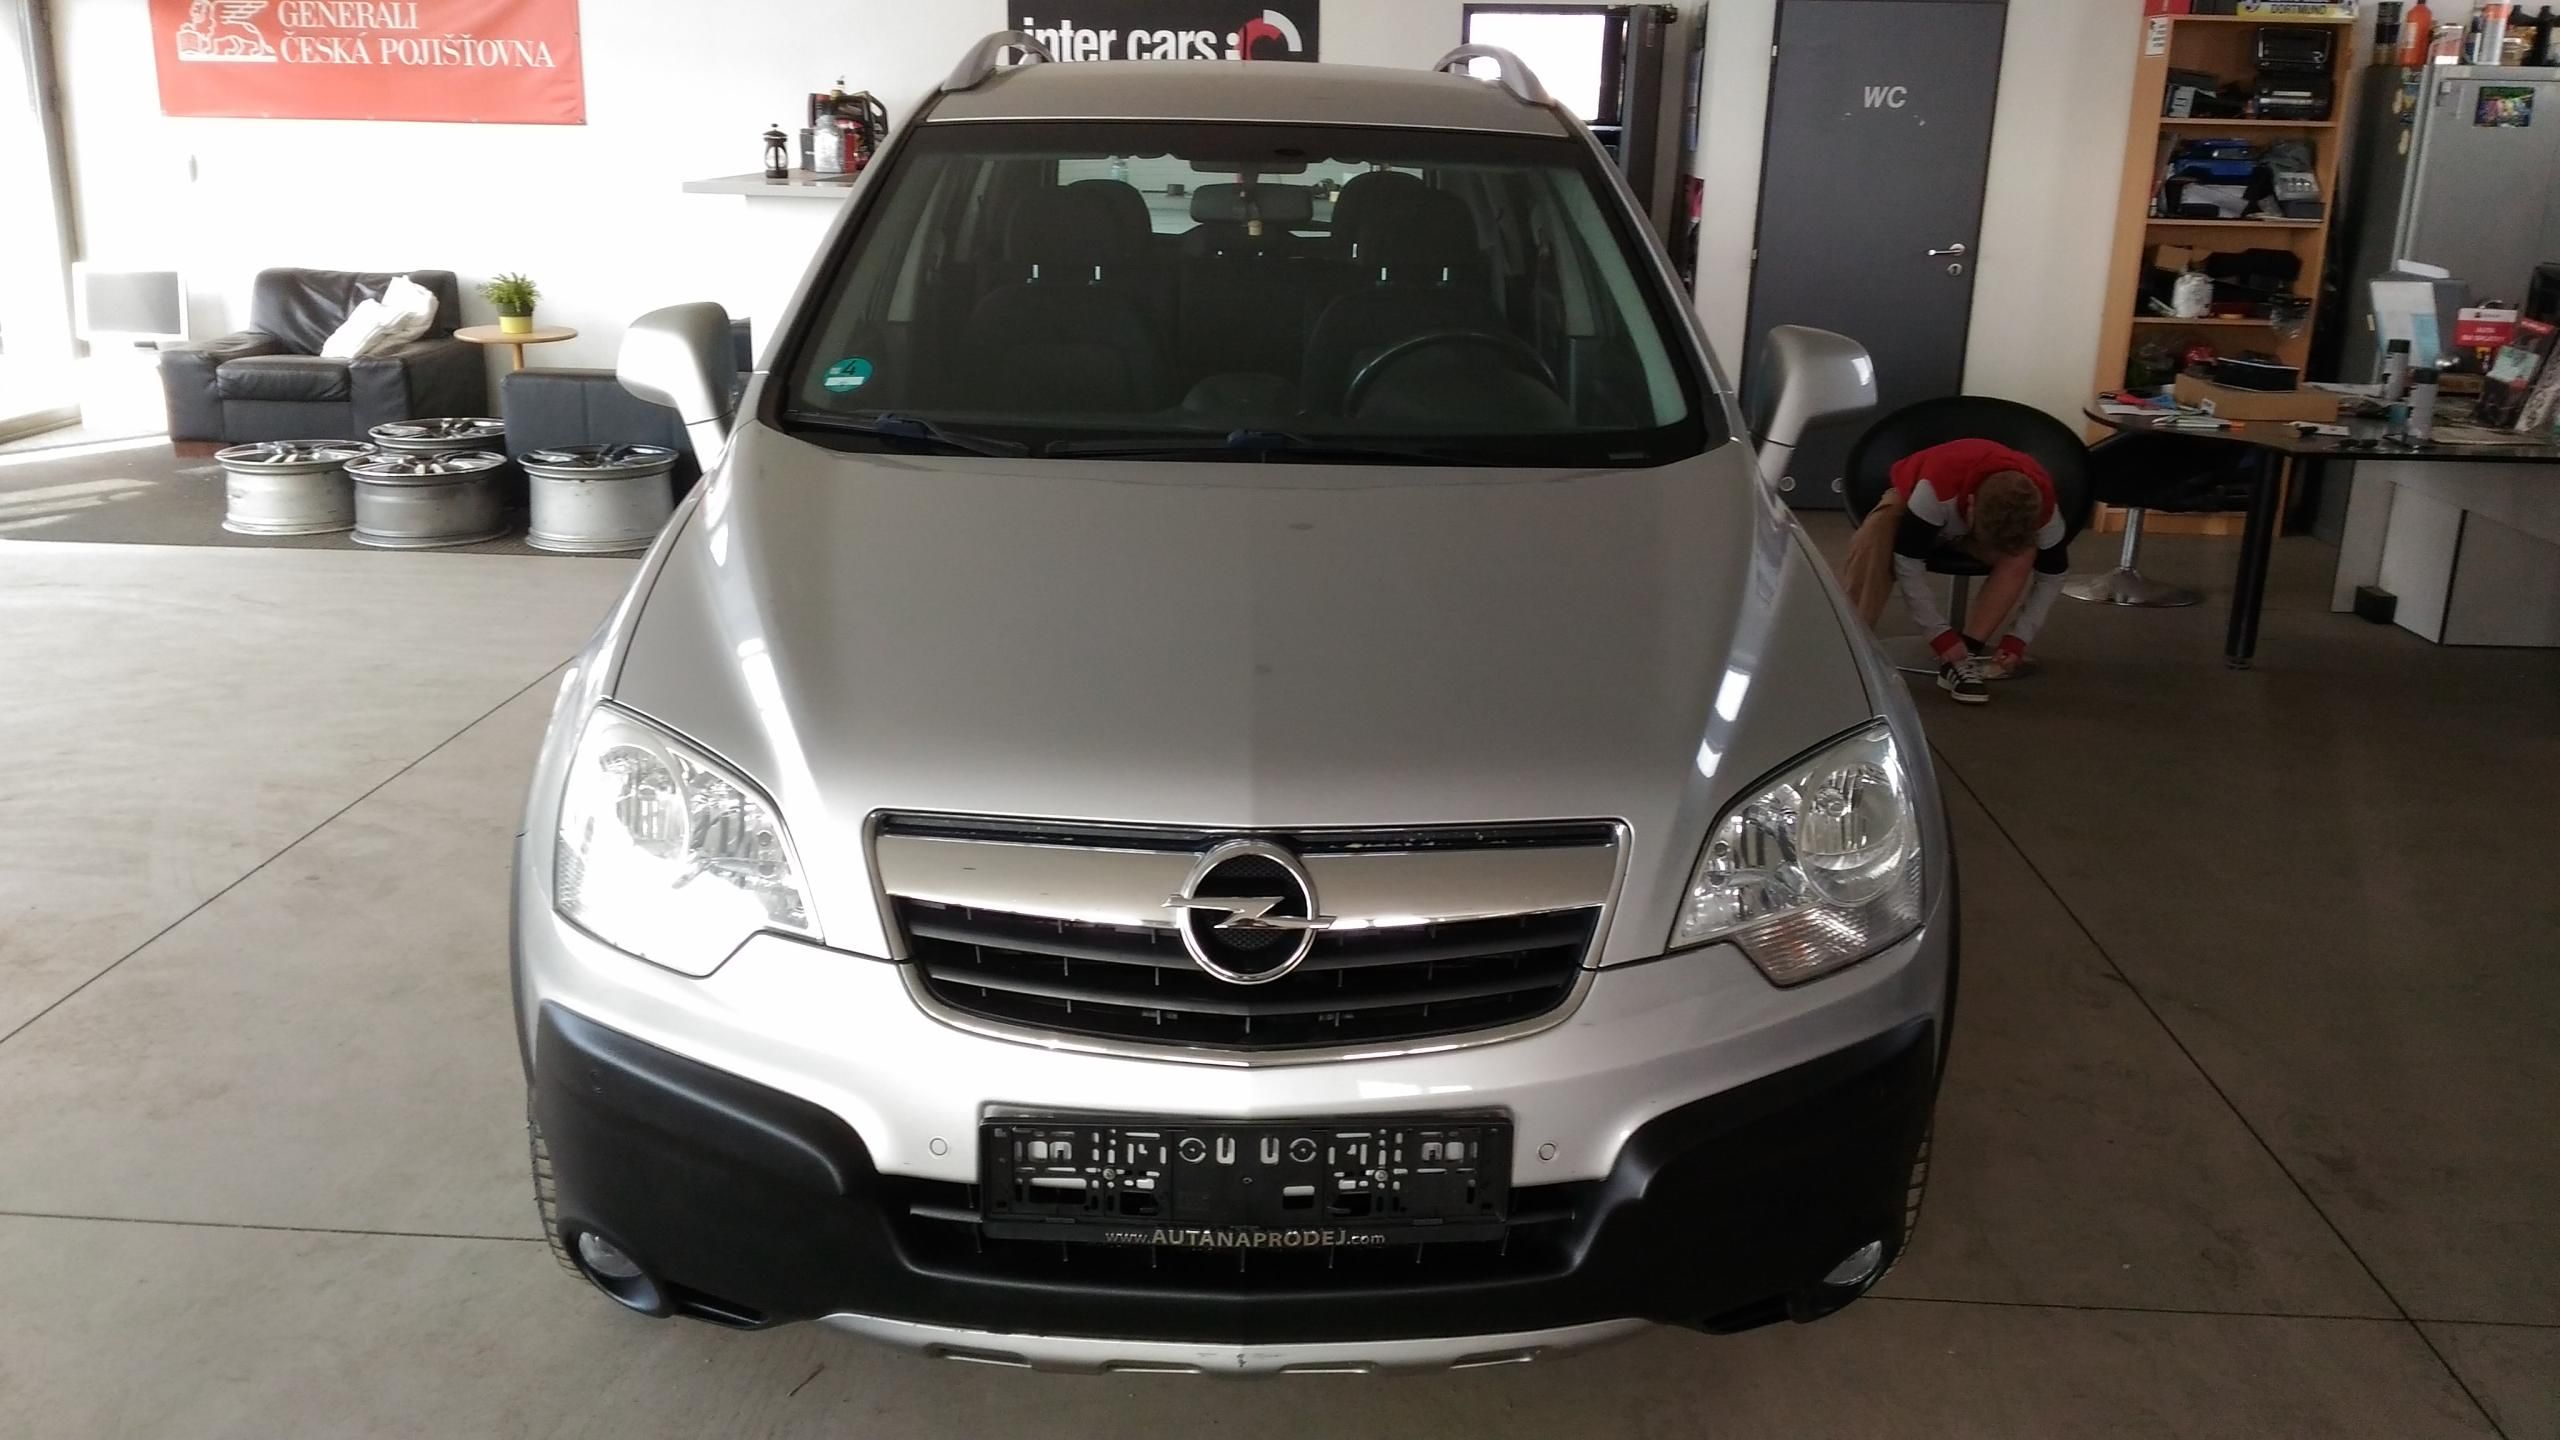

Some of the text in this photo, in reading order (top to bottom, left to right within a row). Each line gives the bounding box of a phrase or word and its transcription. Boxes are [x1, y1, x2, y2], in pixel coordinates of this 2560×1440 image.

[277, 0, 419, 29] GENERALI
[280, 30, 556, 68] ČESKÁ POJIŠŤOVNA
[1127, 28, 1217, 61] cars
[1864, 86, 1908, 108] WC
[841, 359, 856, 376] 4
[1105, 1229, 1386, 1247] www.AUTANAPRODEJ.com
